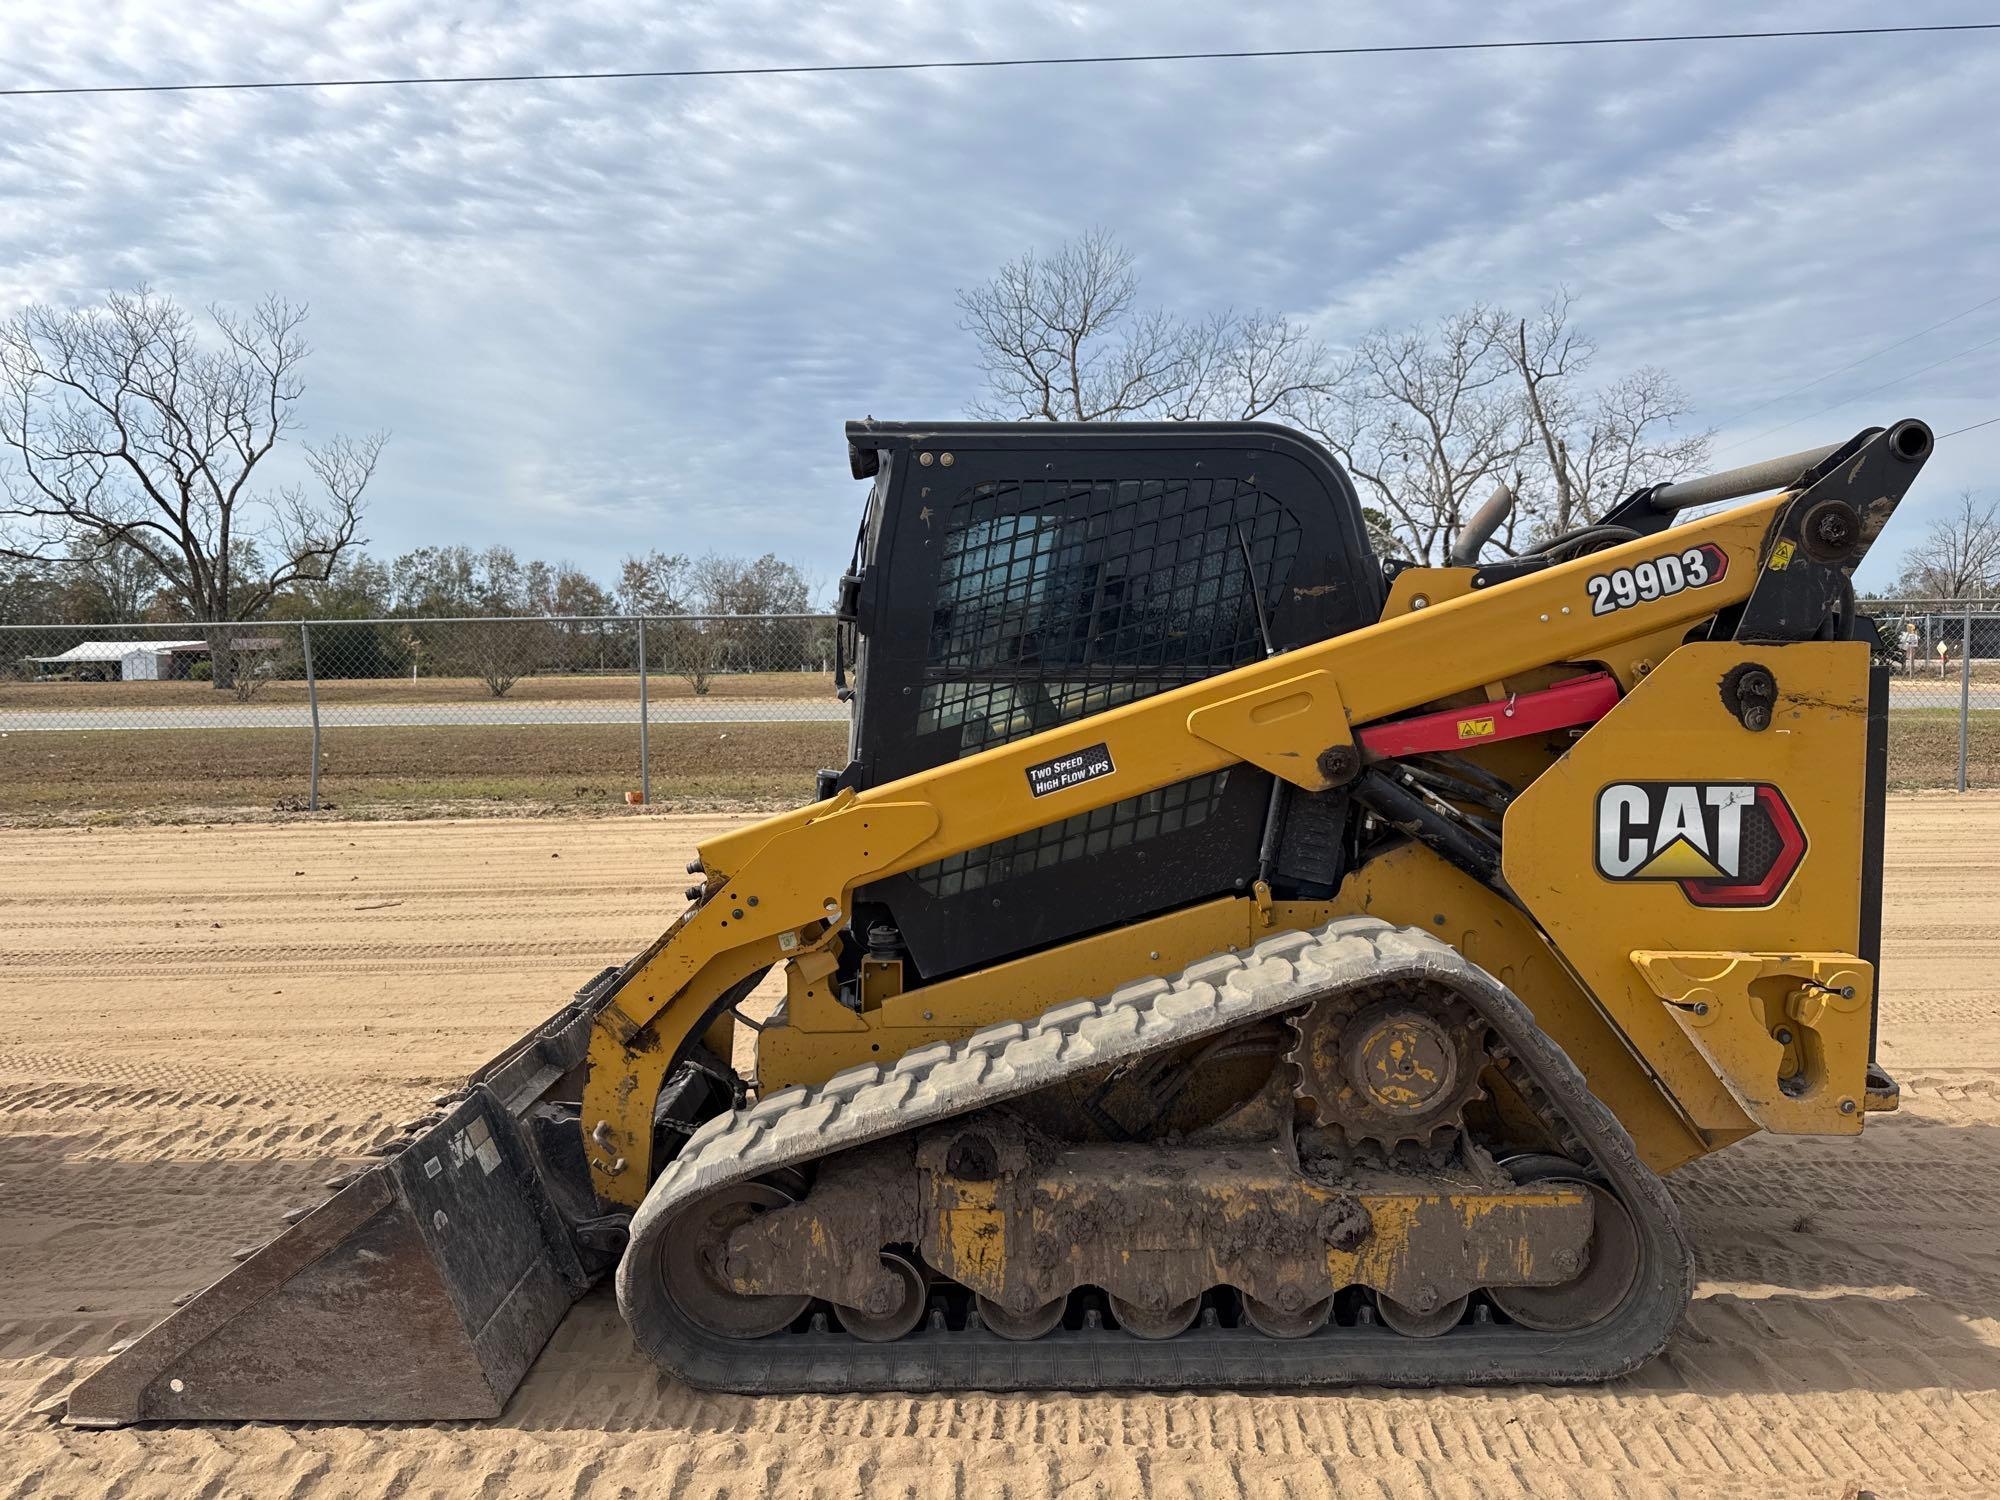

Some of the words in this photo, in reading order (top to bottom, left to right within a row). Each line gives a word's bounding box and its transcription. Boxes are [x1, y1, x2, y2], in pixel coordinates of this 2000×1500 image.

[1588, 549, 1708, 615] 299D3
[1088, 760, 1109, 776] XPS
[1599, 784, 1755, 877] CAT
